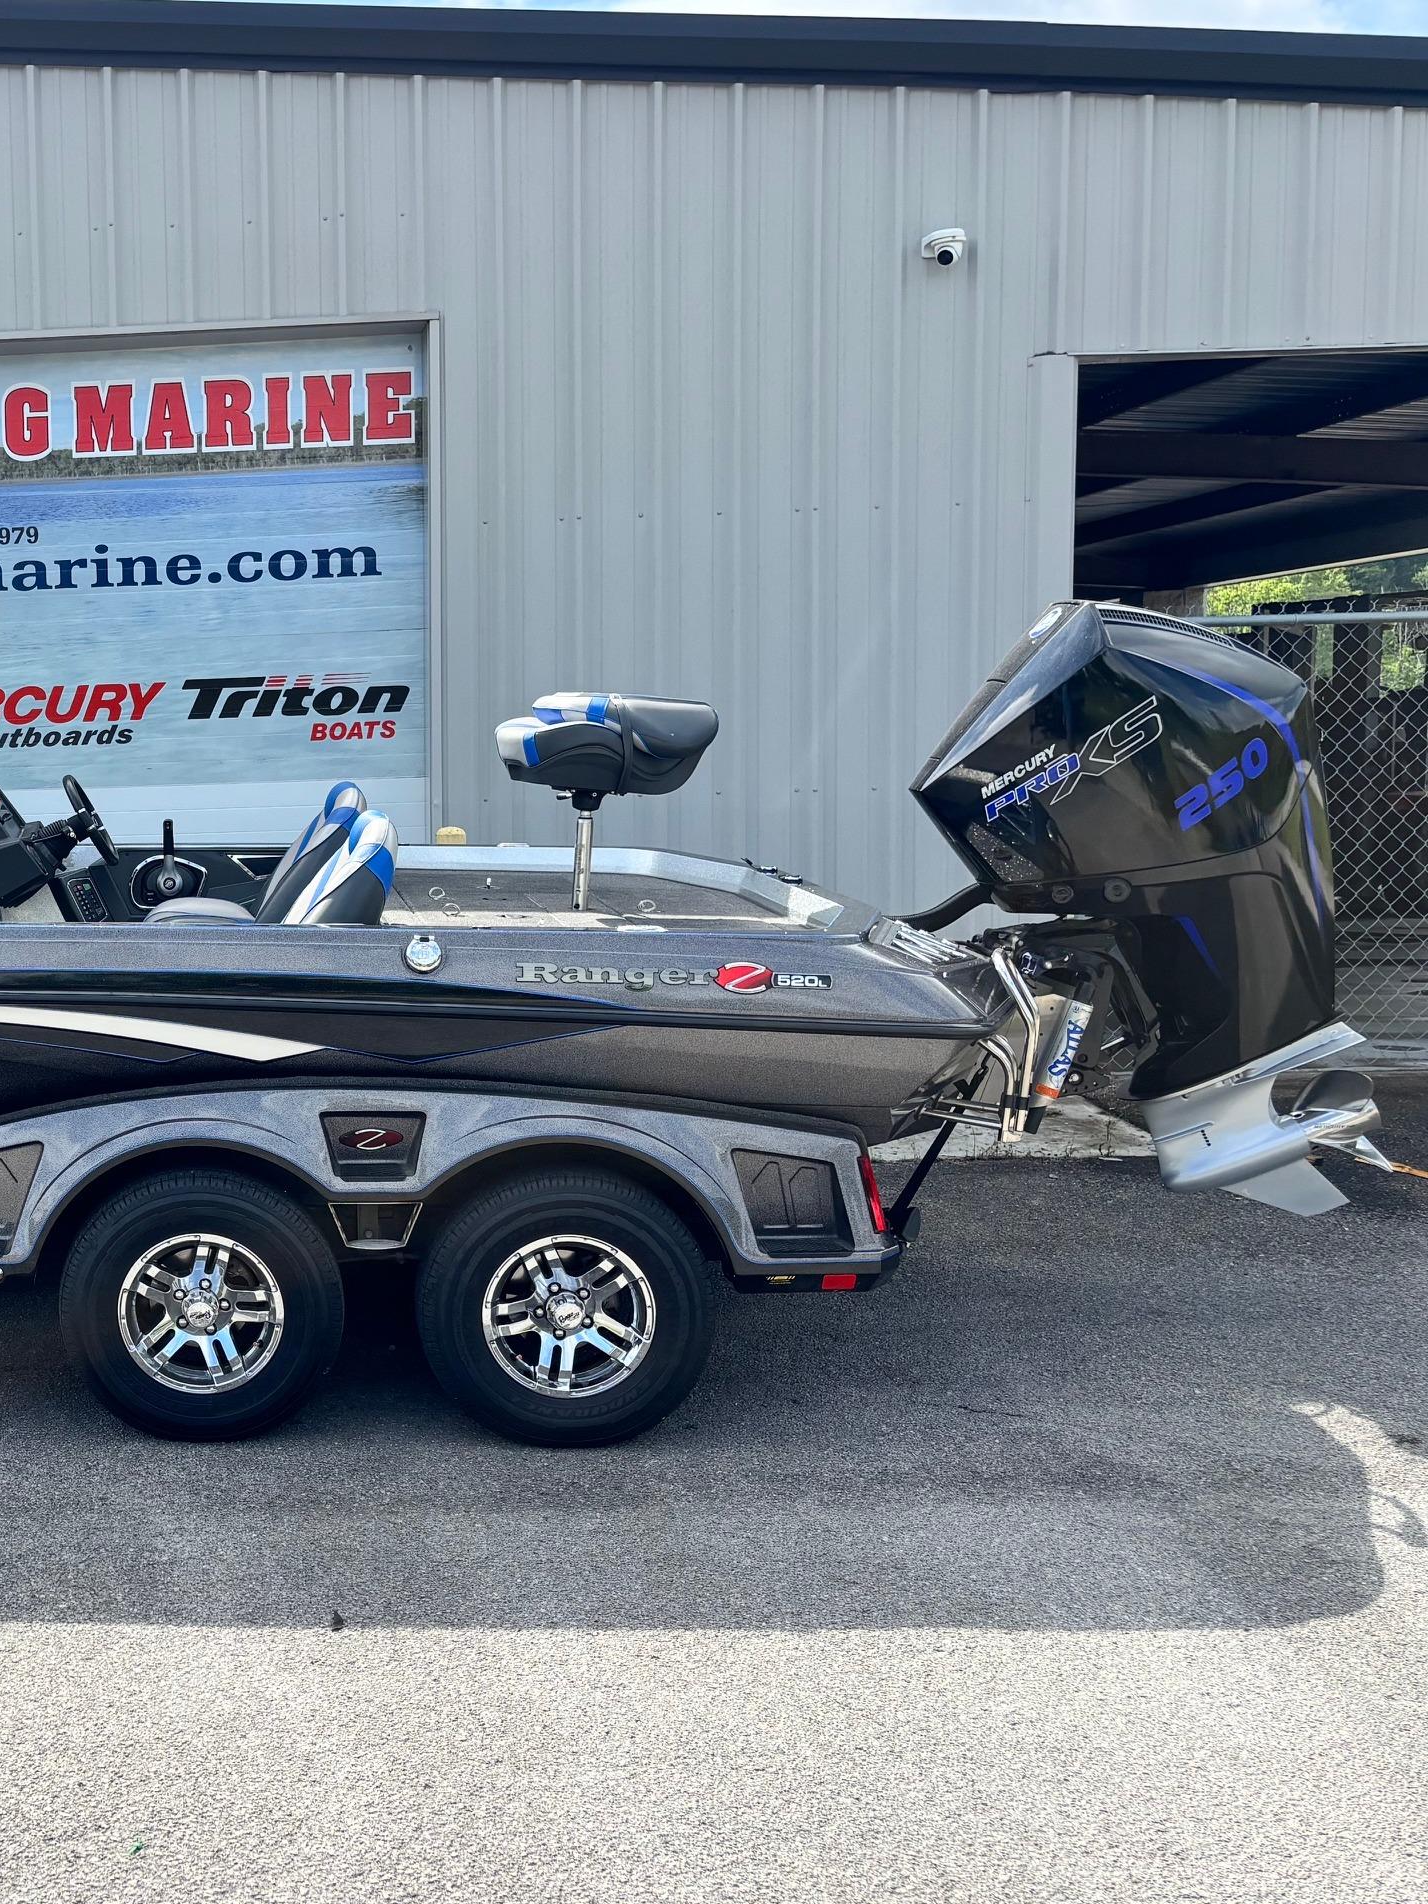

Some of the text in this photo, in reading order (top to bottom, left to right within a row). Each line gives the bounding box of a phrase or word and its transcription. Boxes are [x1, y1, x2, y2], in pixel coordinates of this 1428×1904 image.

[72, 367, 415, 458] MARINE
[182, 674, 410, 720] Triton
[310, 720, 397, 742] BOATS
[974, 752, 1080, 822] PRO
[981, 743, 1056, 799] MERCURY
[1173, 737, 1268, 832] 250
[515, 962, 719, 992] Ranger
[725, 962, 767, 993] Z
[1047, 1019, 1085, 1077] ATLAS
[355, 1128, 387, 1150] Z
